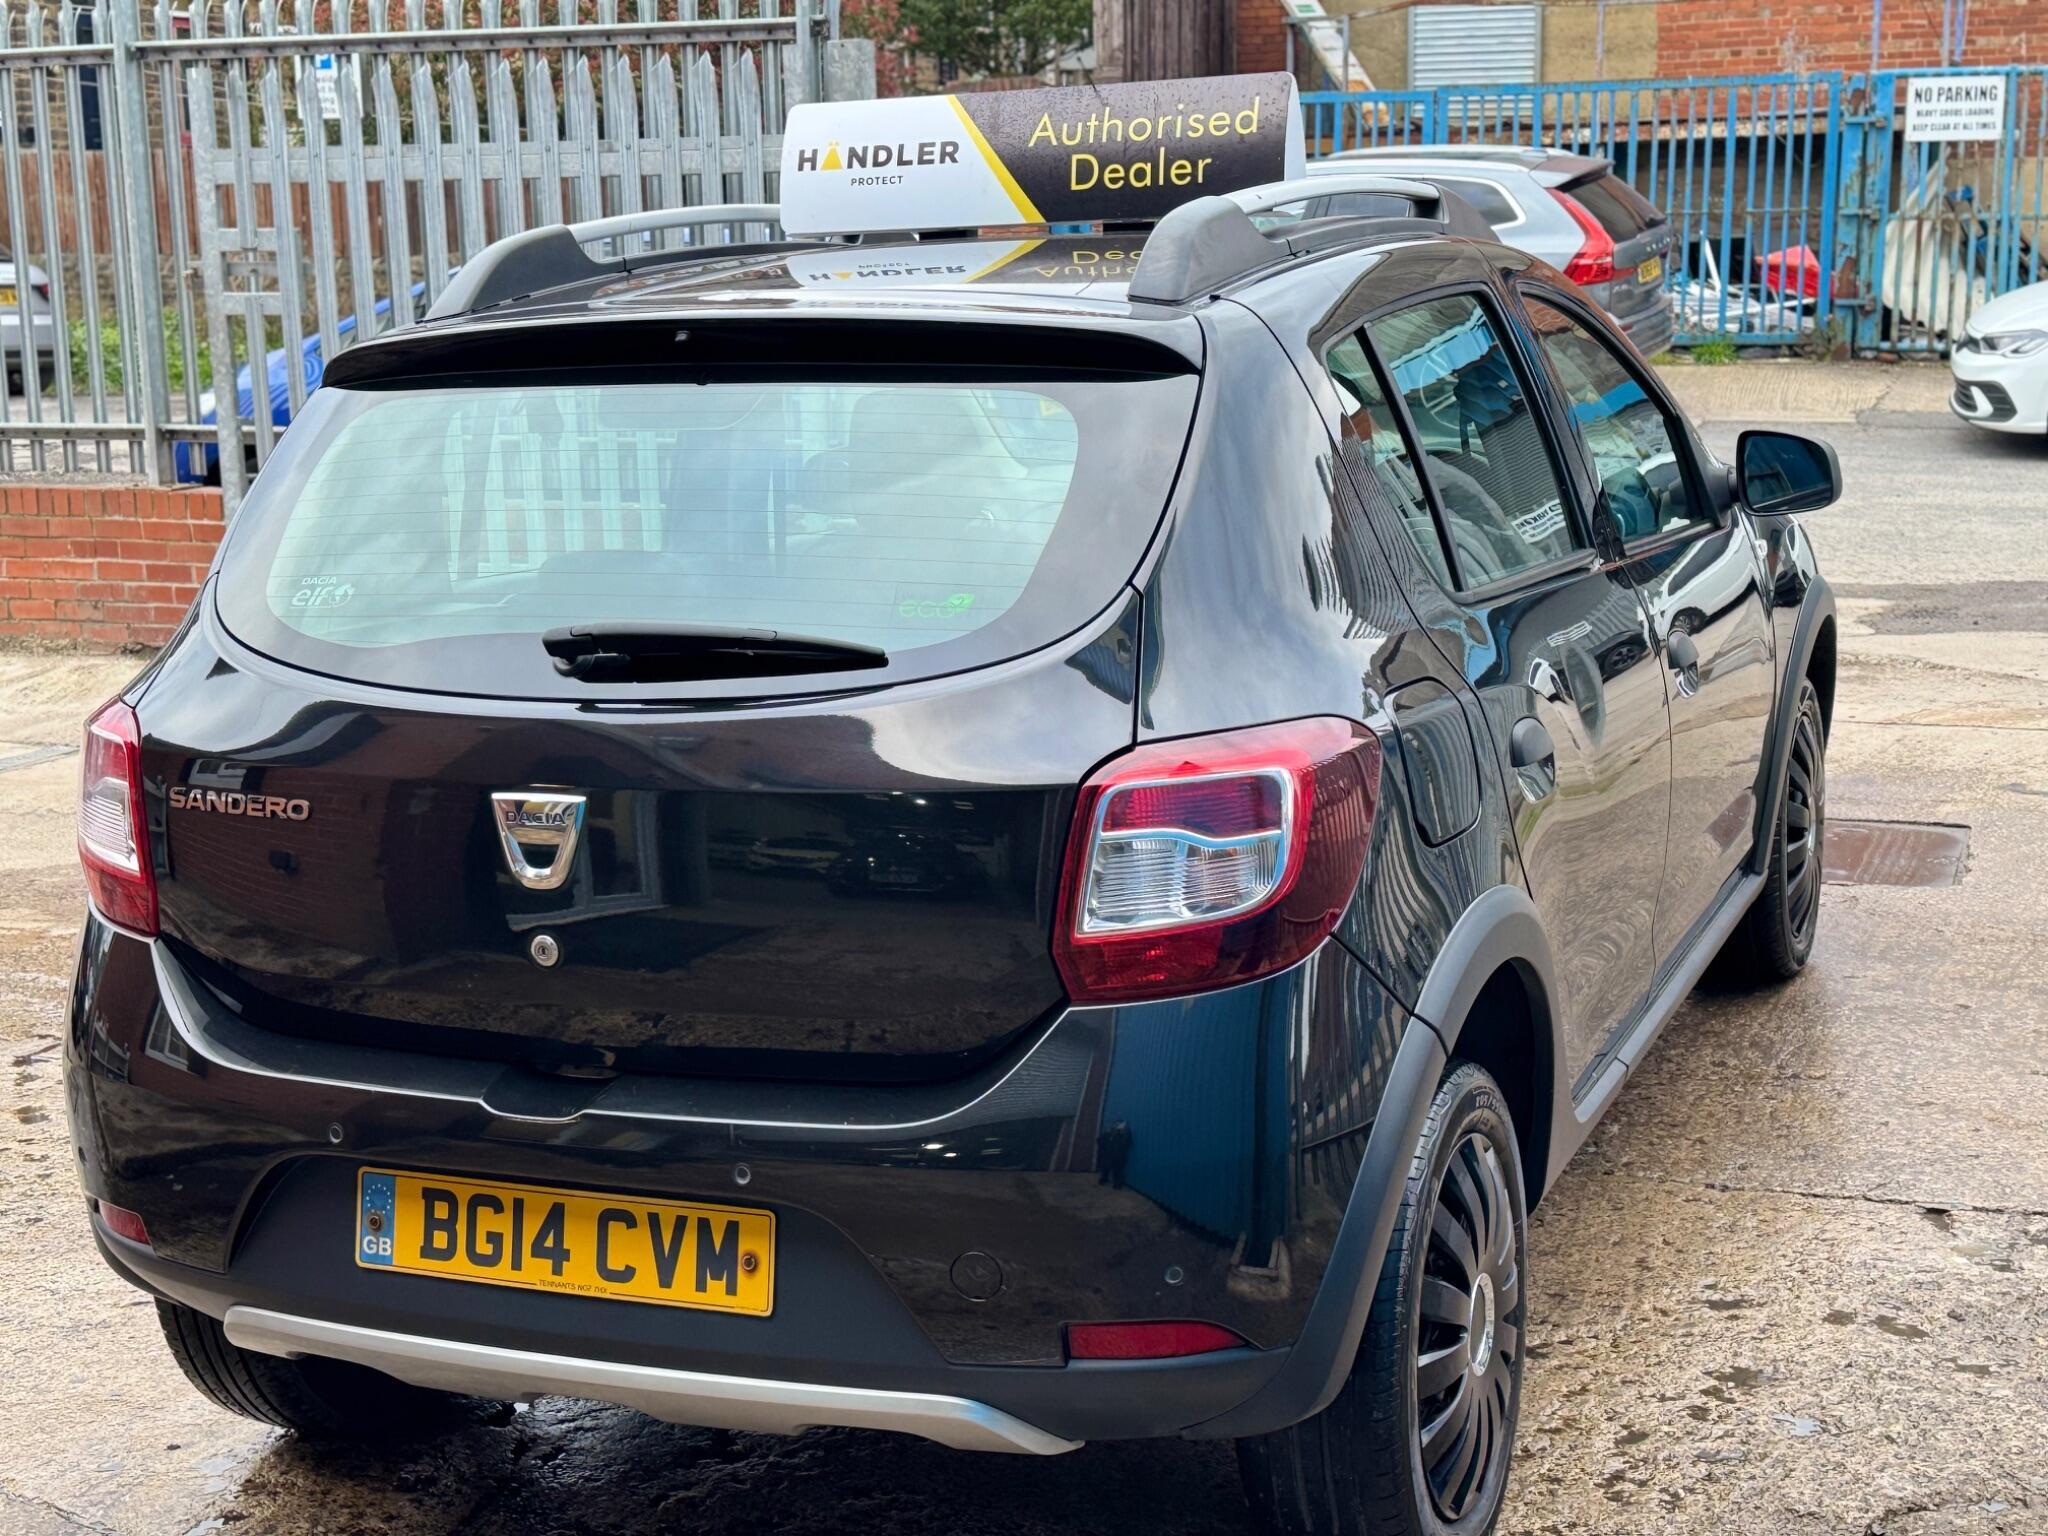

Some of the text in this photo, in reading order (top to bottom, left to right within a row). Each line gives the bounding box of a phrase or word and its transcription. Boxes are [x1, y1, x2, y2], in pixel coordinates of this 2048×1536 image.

[1914, 85, 1998, 103] NO PARKING
[1028, 96, 1260, 147] Authorised
[1071, 147, 1213, 190] Dealer
[850, 175, 904, 187] PROTECT
[302, 575, 337, 585] DACIA
[169, 786, 311, 821] SANDERO
[505, 810, 566, 825] DACIA
[362, 1235, 392, 1257] GB
[420, 1186, 740, 1297] BG14 CVM
